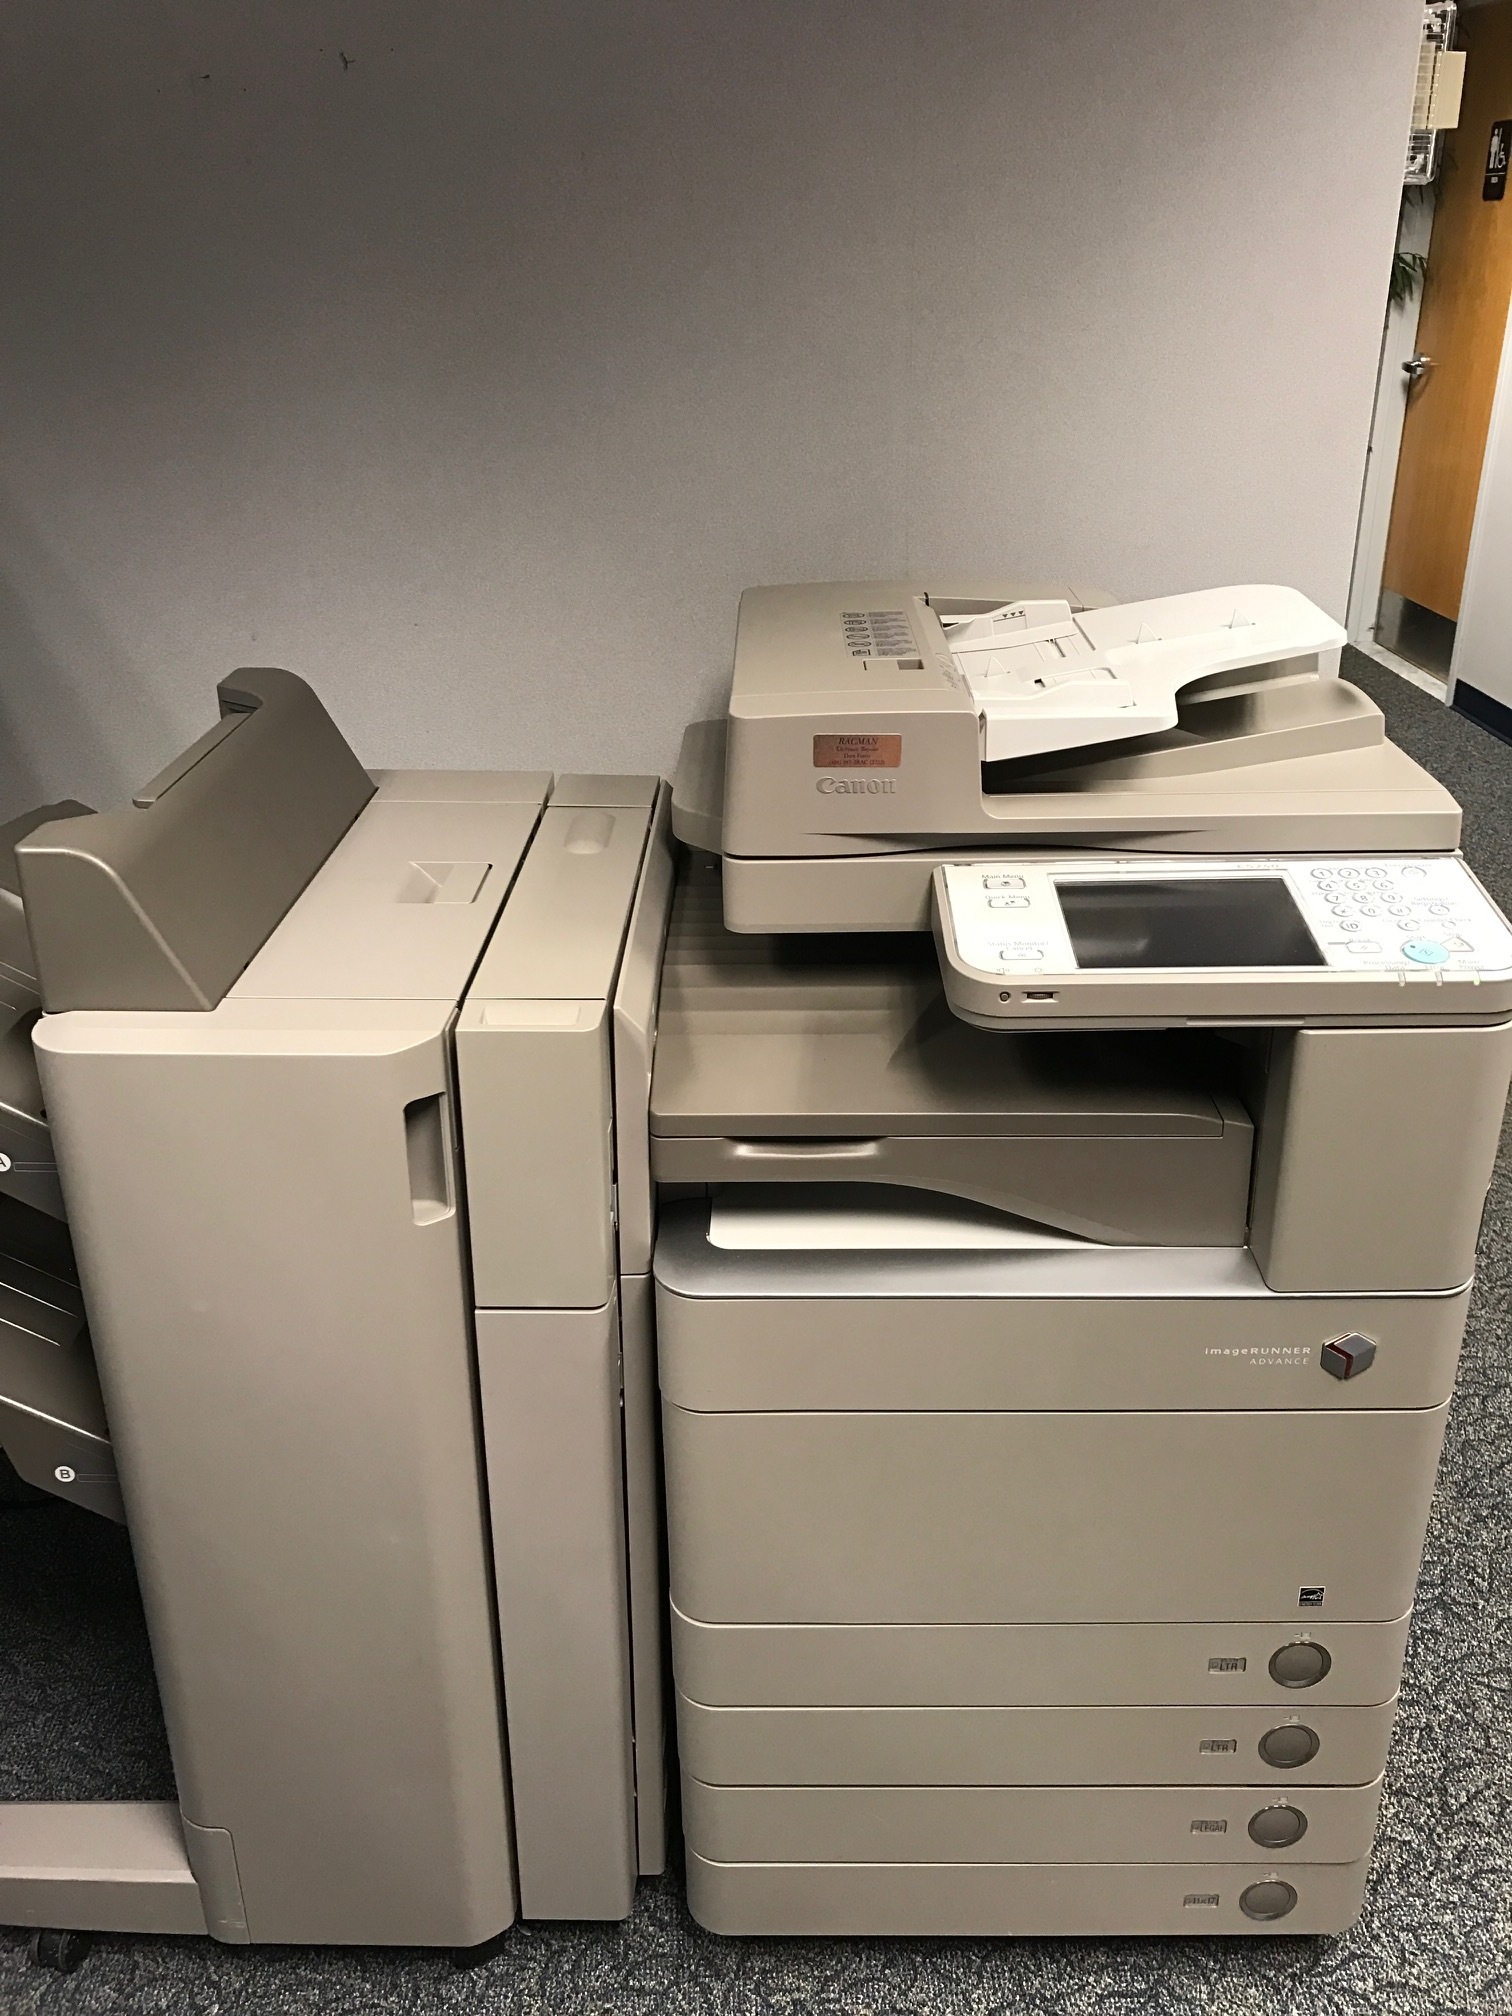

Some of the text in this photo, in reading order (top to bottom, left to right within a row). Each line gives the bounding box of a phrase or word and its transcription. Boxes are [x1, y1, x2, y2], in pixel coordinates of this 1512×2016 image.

[838, 737, 879, 745] RACMAN
[815, 776, 897, 795] Canon
[1204, 1347, 1311, 1356] imageRUNNER
[1249, 1357, 1309, 1365] ADVANCE
[60, 1469, 71, 1479] B
[1219, 1662, 1239, 1672] LTR
